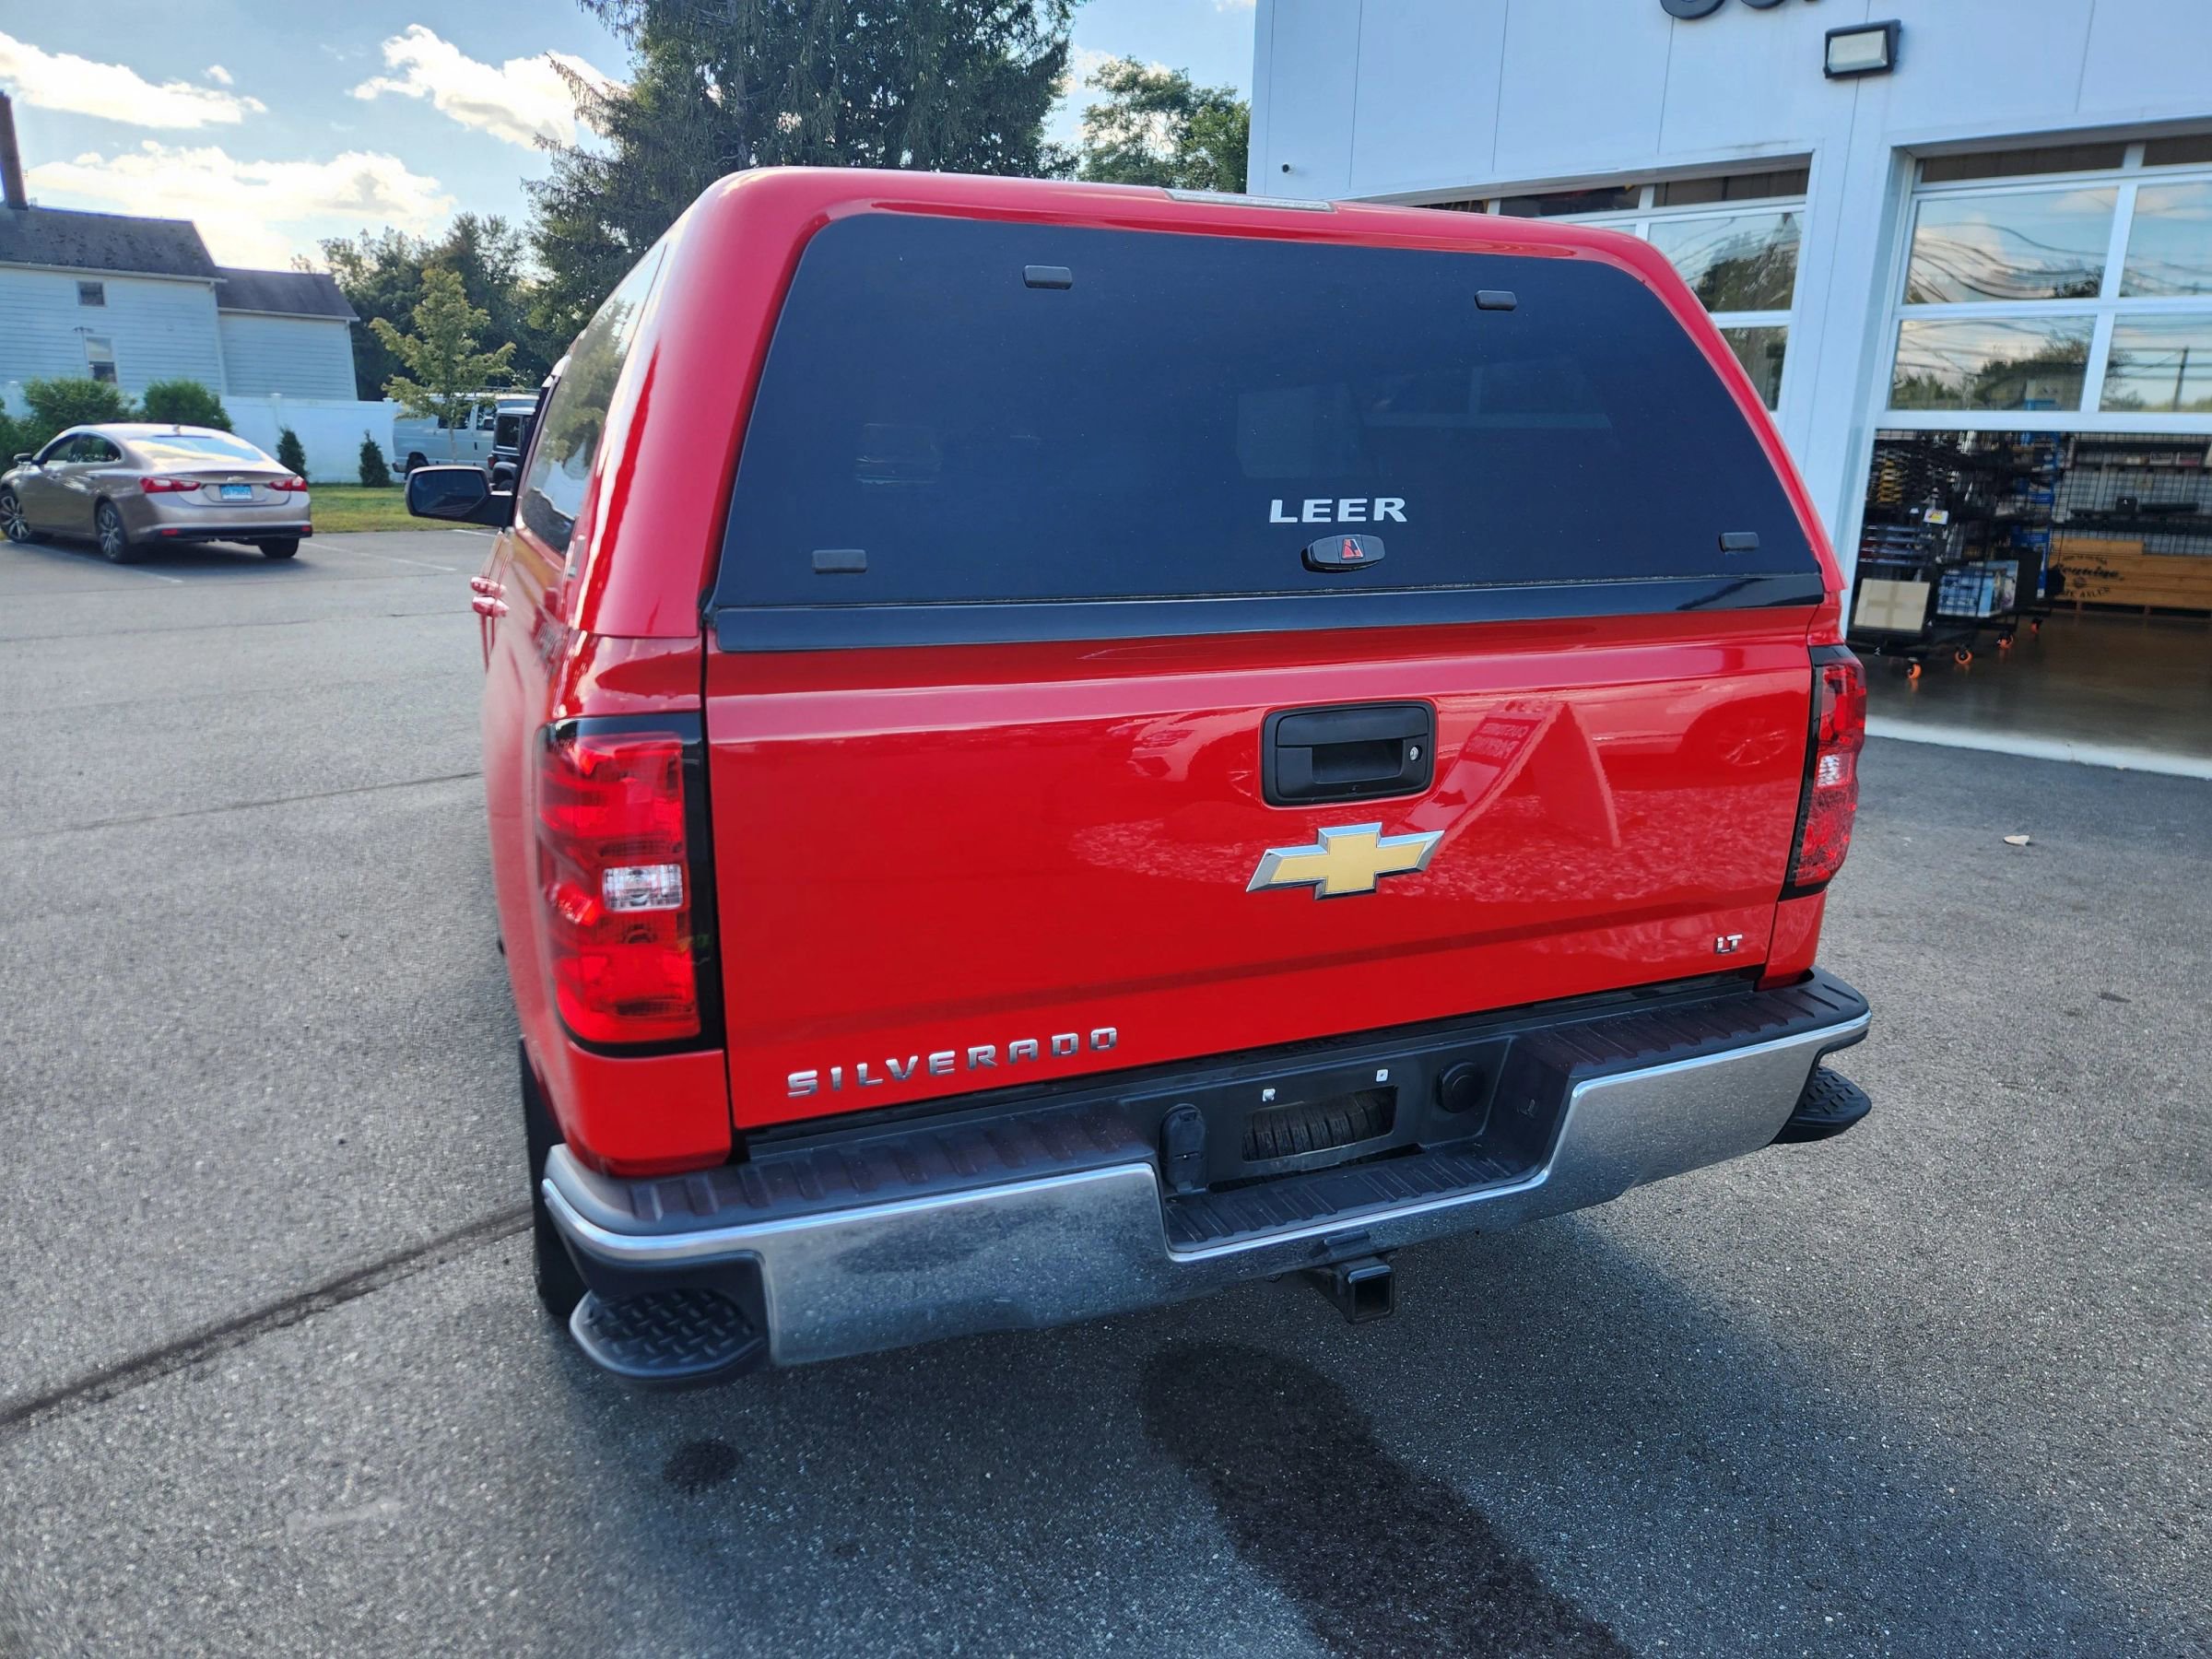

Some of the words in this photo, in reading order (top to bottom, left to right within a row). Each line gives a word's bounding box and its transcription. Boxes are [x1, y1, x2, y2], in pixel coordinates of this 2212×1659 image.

[1269, 498, 1407, 523] LEER
[1717, 934, 1743, 953] LT
[787, 1027, 1118, 1098] SILVERADO
